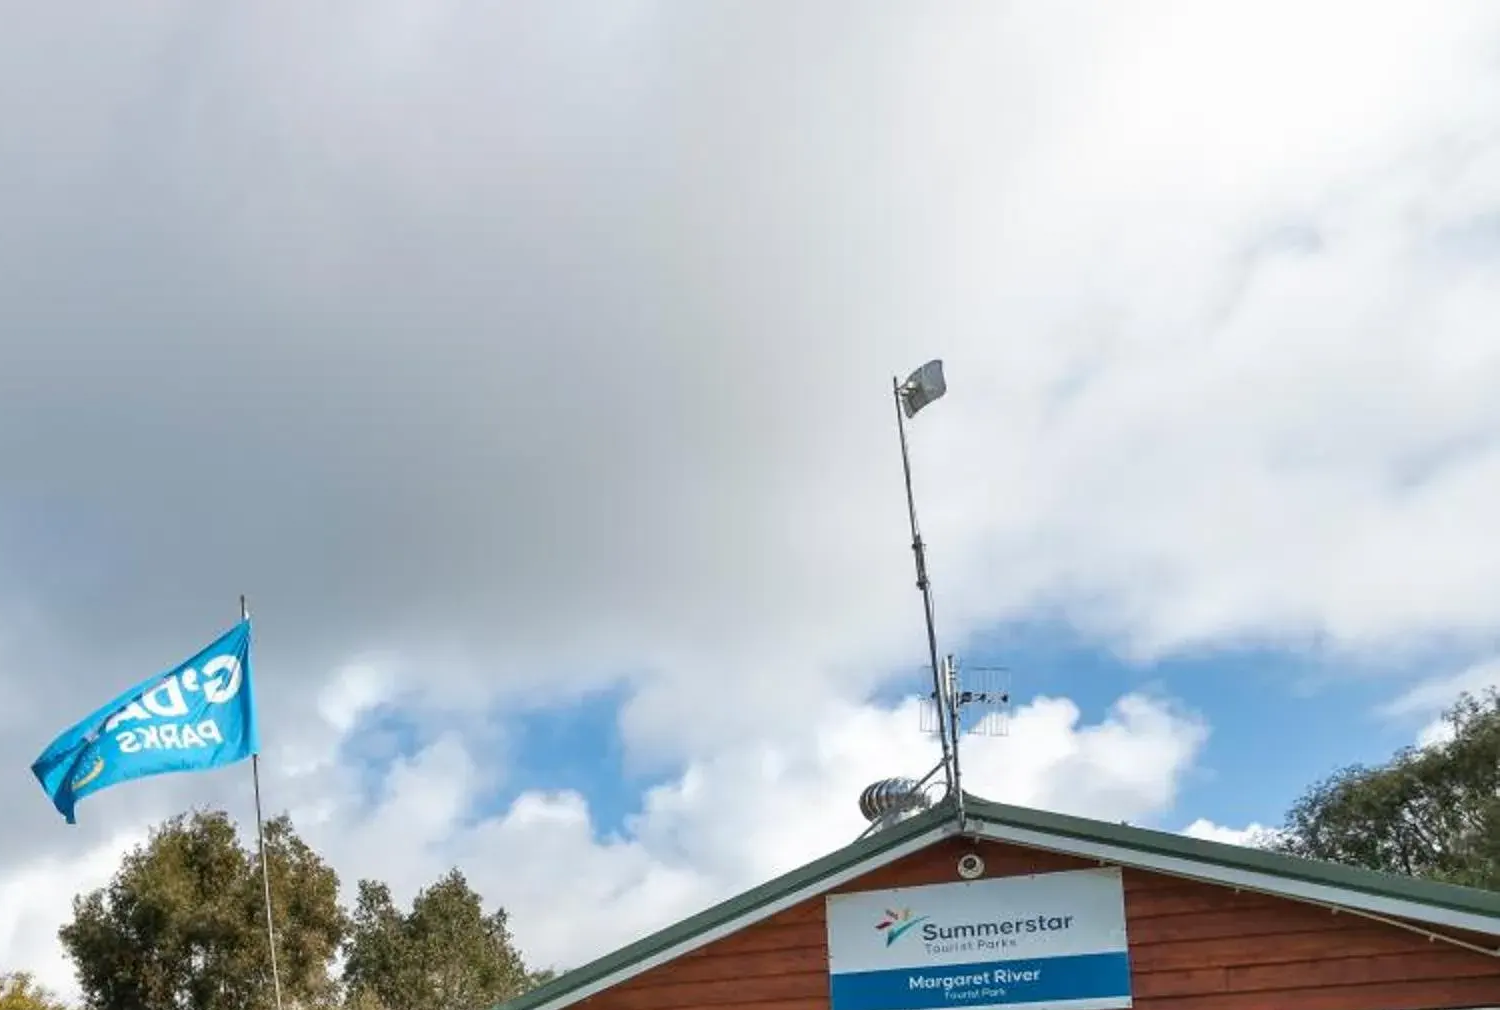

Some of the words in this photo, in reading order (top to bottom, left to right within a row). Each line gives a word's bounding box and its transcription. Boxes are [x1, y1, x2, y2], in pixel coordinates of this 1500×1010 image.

[922, 914, 1074, 941] Summerstar
[926, 941, 972, 954] Tourist
[977, 938, 1017, 950] Parks
[908, 970, 990, 990] Margaret
[994, 968, 1041, 983] River
[945, 989, 979, 1000] Tourist
[982, 987, 1006, 998] Park
